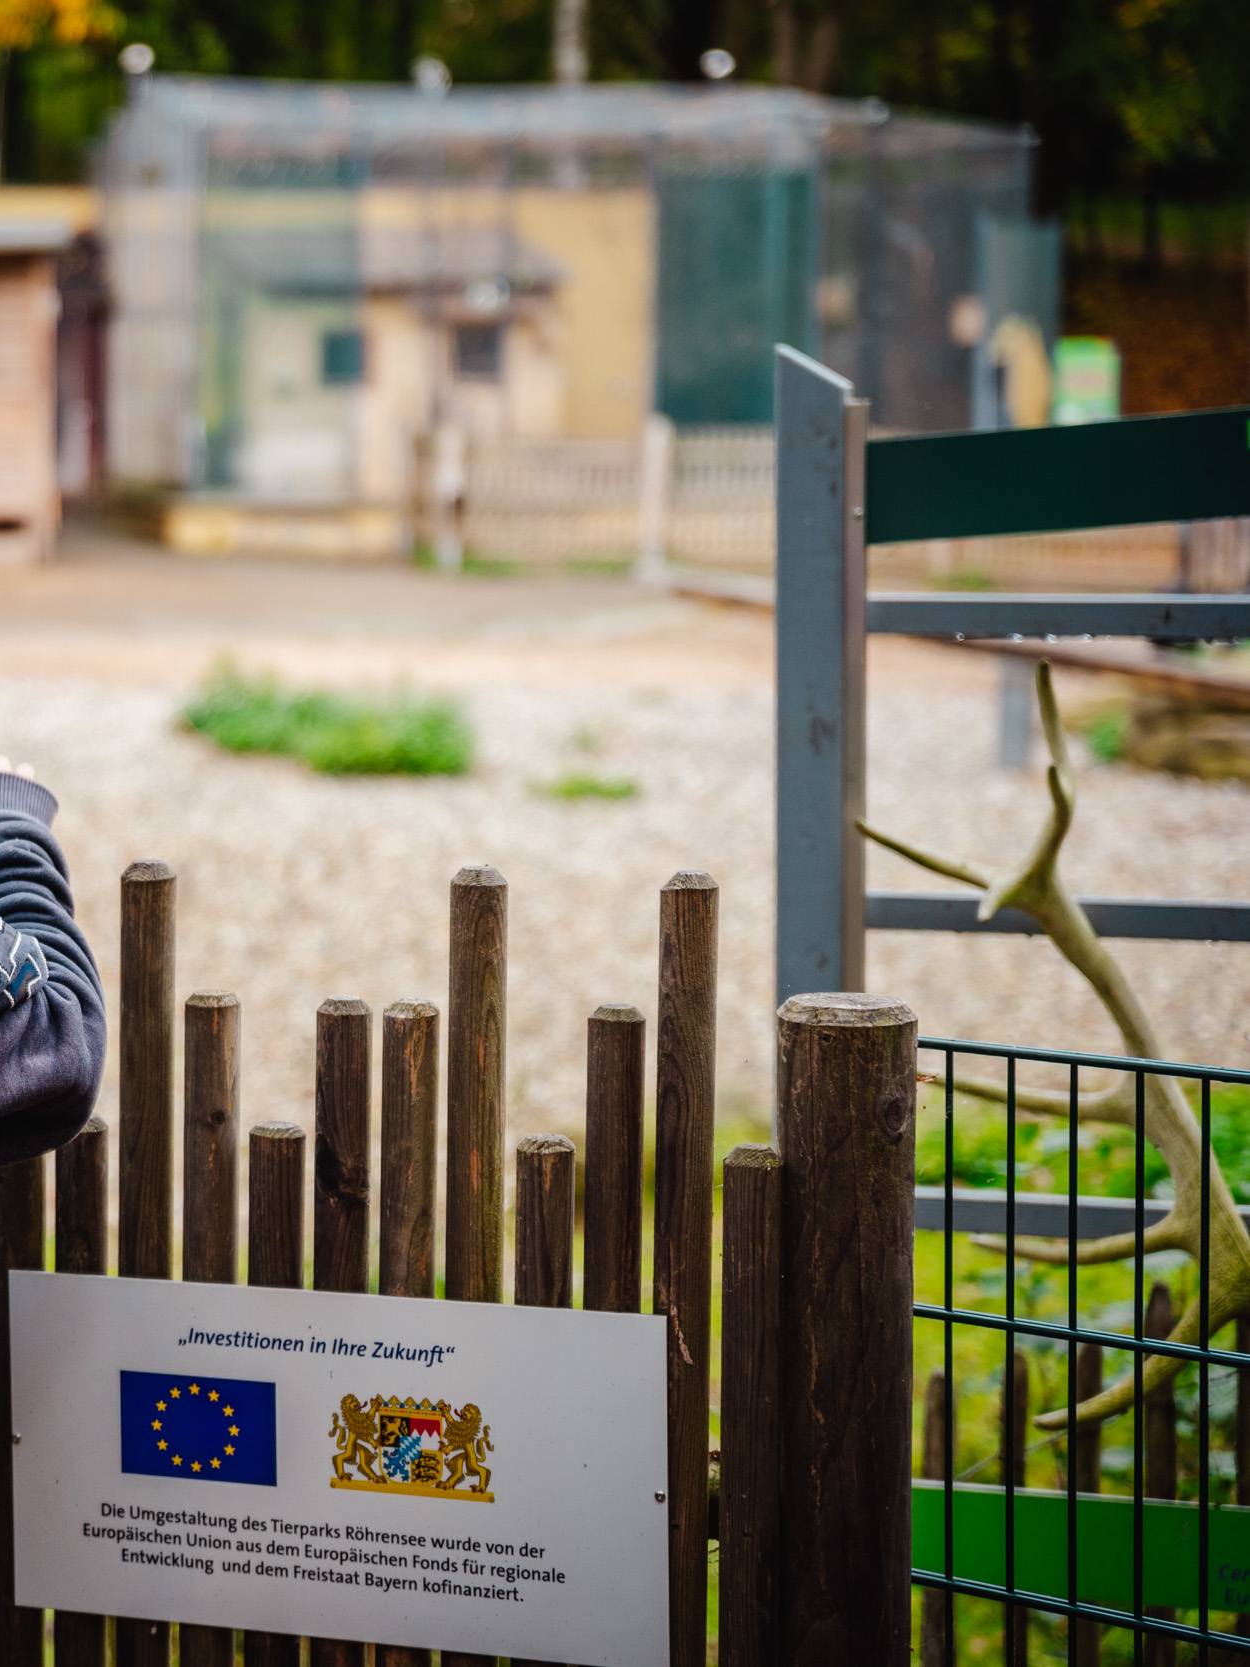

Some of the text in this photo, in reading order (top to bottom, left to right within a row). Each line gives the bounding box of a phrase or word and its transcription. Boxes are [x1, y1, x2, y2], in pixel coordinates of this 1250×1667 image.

[309, 1335, 327, 1355] in
[331, 1338, 368, 1358] Ihre
[371, 1342, 456, 1368] Zukunft“
[83, 1522, 566, 1584] Europäischen Union aus dem Europäischen Fonds für regionale
[100, 1503, 546, 1559] Die Umgestaltung des Tierparks Röhrensee wurde von der
[121, 1547, 524, 1603] Entwicklung und dem Freistaat Bayern kofinanziert.
